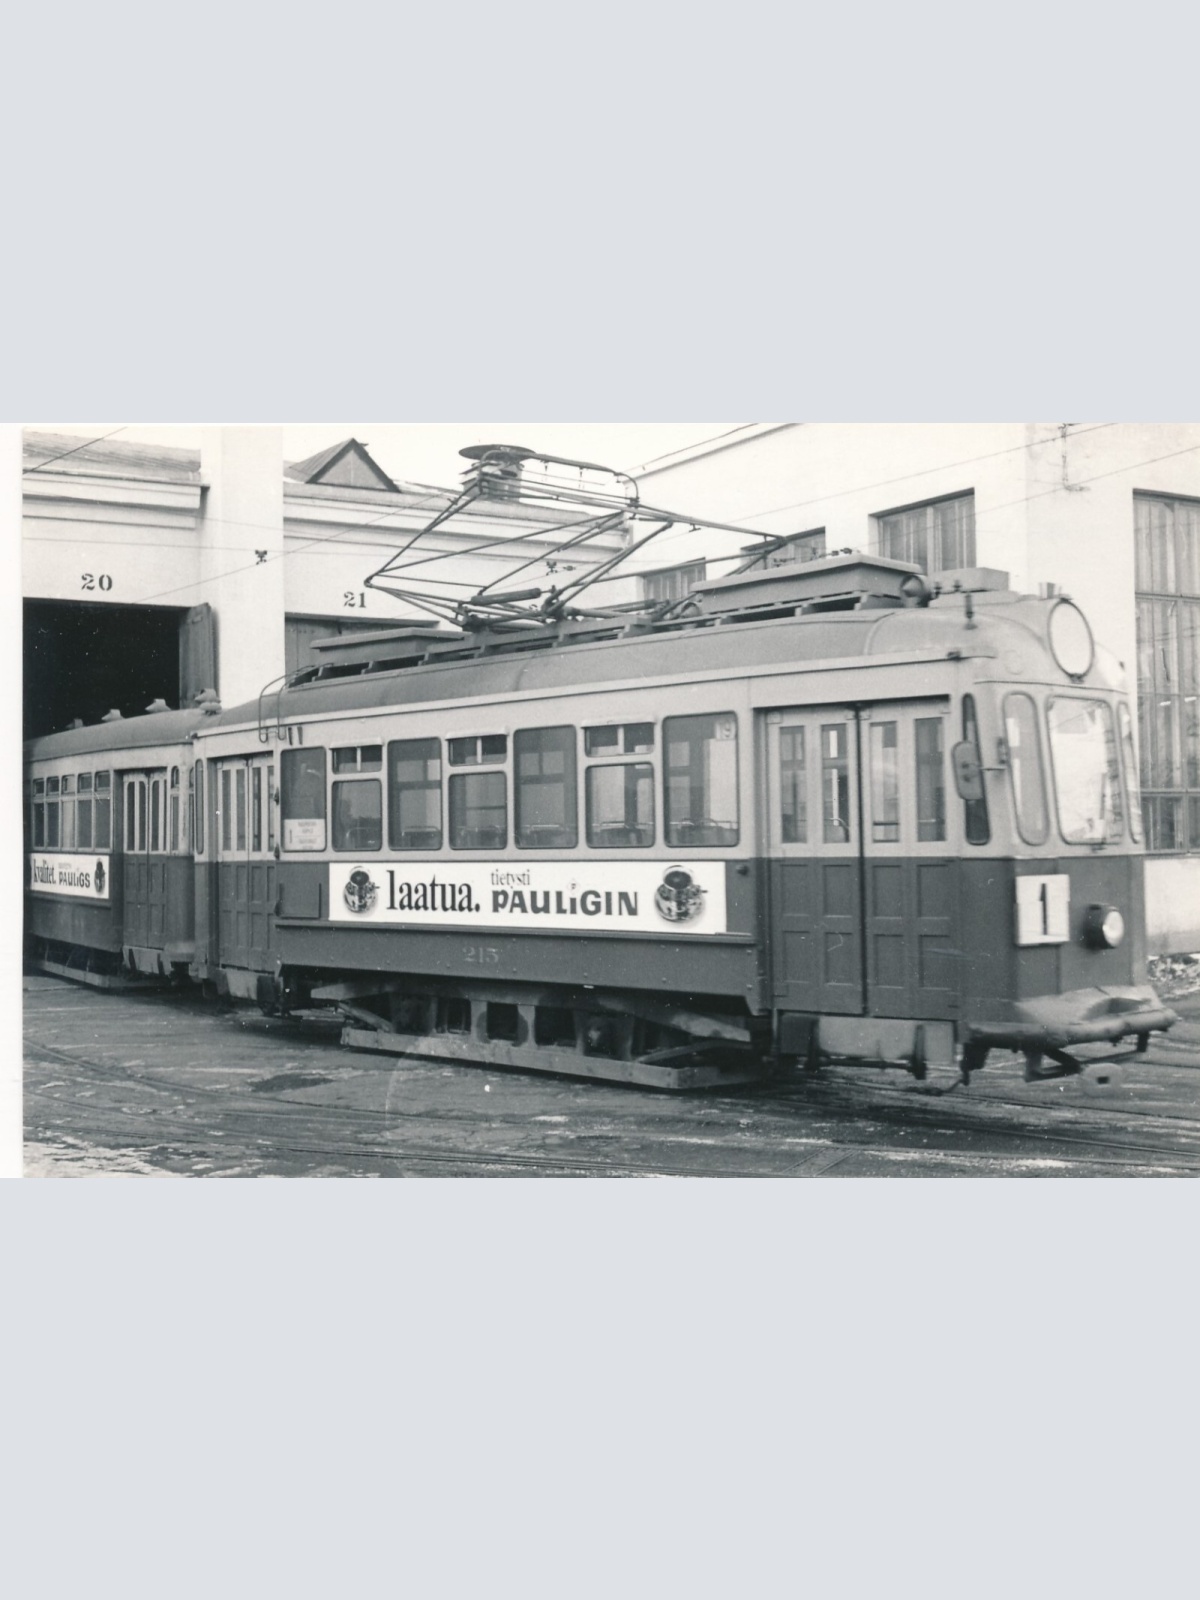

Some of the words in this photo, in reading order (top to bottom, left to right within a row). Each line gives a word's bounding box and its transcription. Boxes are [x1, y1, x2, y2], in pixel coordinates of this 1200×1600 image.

[81, 573, 113, 591] 20
[343, 591, 366, 608] 21
[491, 868, 530, 889] tietysti
[386, 869, 480, 912] laatua.
[1039, 882, 1047, 935] 1
[463, 946, 499, 963] 215
